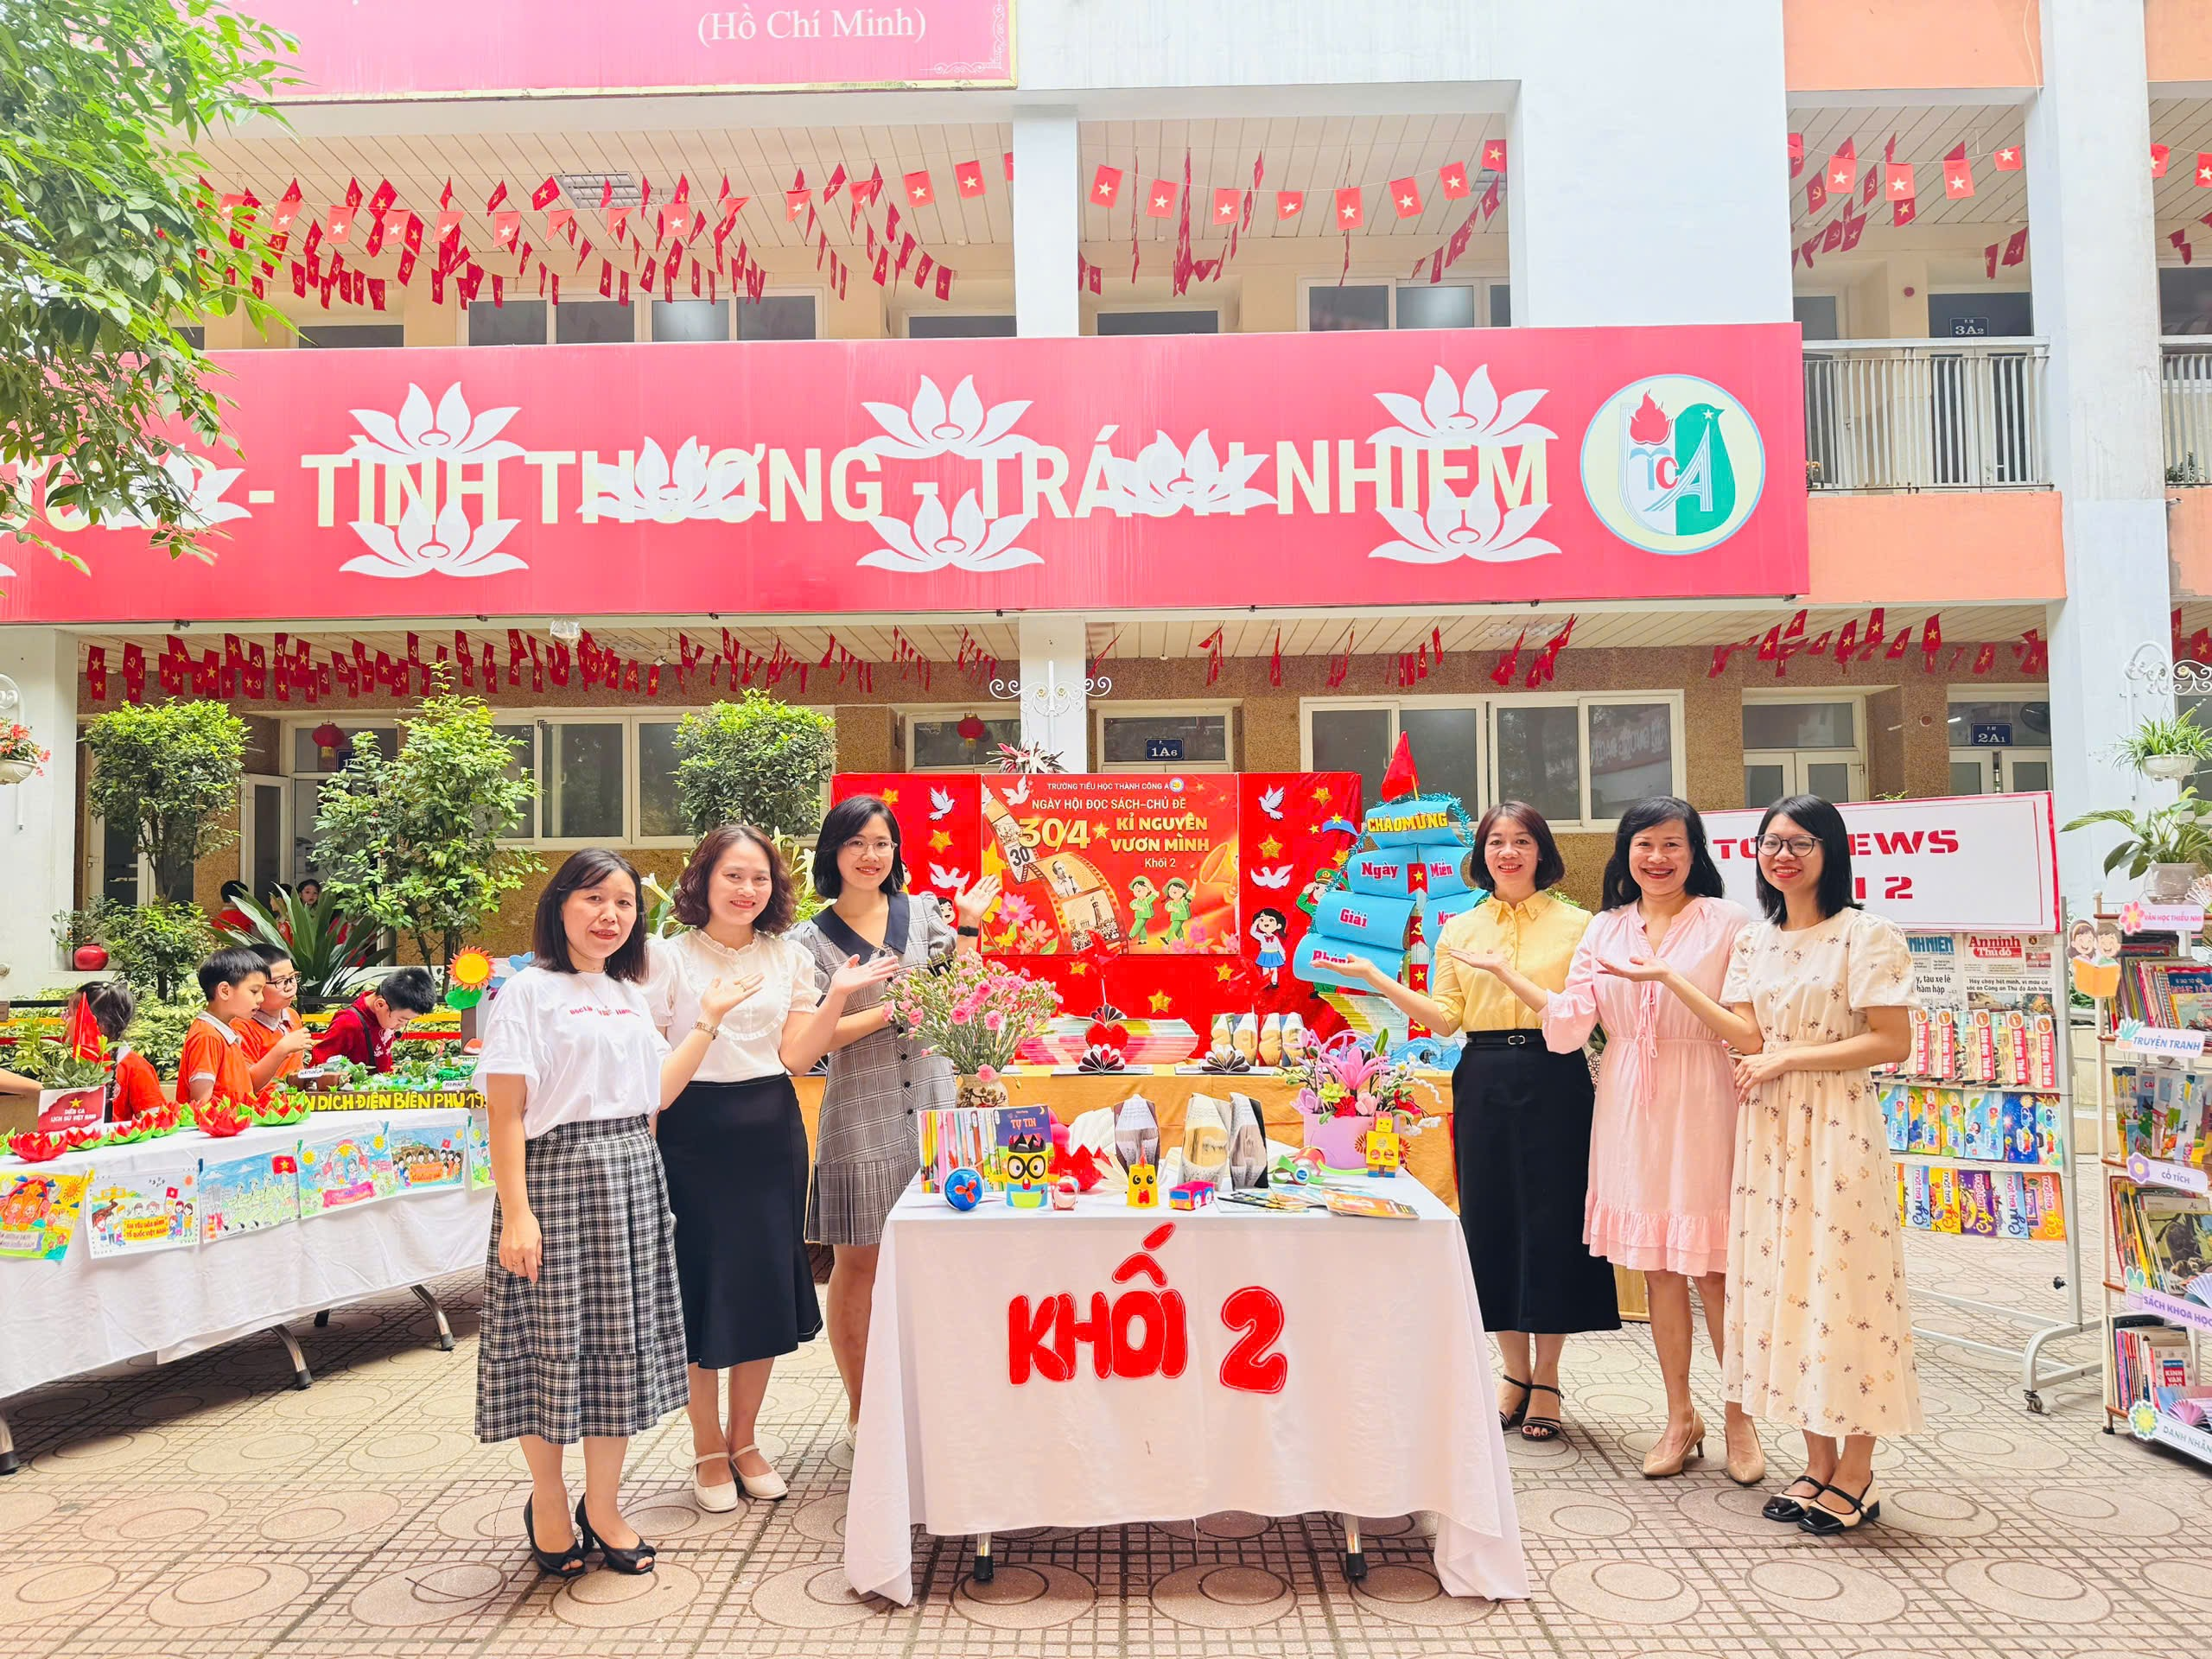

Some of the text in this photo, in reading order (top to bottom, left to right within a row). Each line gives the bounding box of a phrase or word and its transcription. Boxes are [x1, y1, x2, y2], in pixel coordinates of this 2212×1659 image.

[698, 7, 927, 48] (Hồ Chí Minh)
[301, 435, 499, 527] TÌNH
[524, 442, 882, 524] THƯƠNG
[1152, 747, 1178, 757] 1A6
[1047, 781, 1078, 790] TRƯỜNG
[1097, 783, 1114, 791] HỌC
[1115, 781, 1140, 790] THÀNH
[1141, 781, 1162, 790] CÔNG
[1032, 798, 1060, 810] NGÀY
[1064, 799, 1084, 810] HỘI
[1086, 800, 1109, 810] ĐỌC
[1172, 797, 1186, 809] ĐỀ
[1139, 812, 1208, 831] NGUYÊN
[1019, 817, 1090, 852] 30/4
[1110, 834, 1209, 852] VƯƠN MÌNH
[1010, 846, 1031, 867] 30
[1170, 859, 1176, 868] 2
[1362, 861, 1398, 879] Ngày
[1885, 876, 1913, 899] 2
[1340, 909, 1368, 927] Giải
[2133, 1035, 2201, 1050] TRUYỆN TRANH
[356, 1091, 391, 1110] ĐIỆN
[394, 1091, 431, 1109] BIÊN
[433, 1090, 466, 1108] PHỦ
[2173, 1173, 2190, 1184] TÍCH
[1007, 1221, 1288, 1394] KHỐI 2
[2144, 1295, 2165, 1310] SÁCH
[2167, 1304, 2193, 1319] KHOA
[2164, 1426, 2187, 1441] DANH
